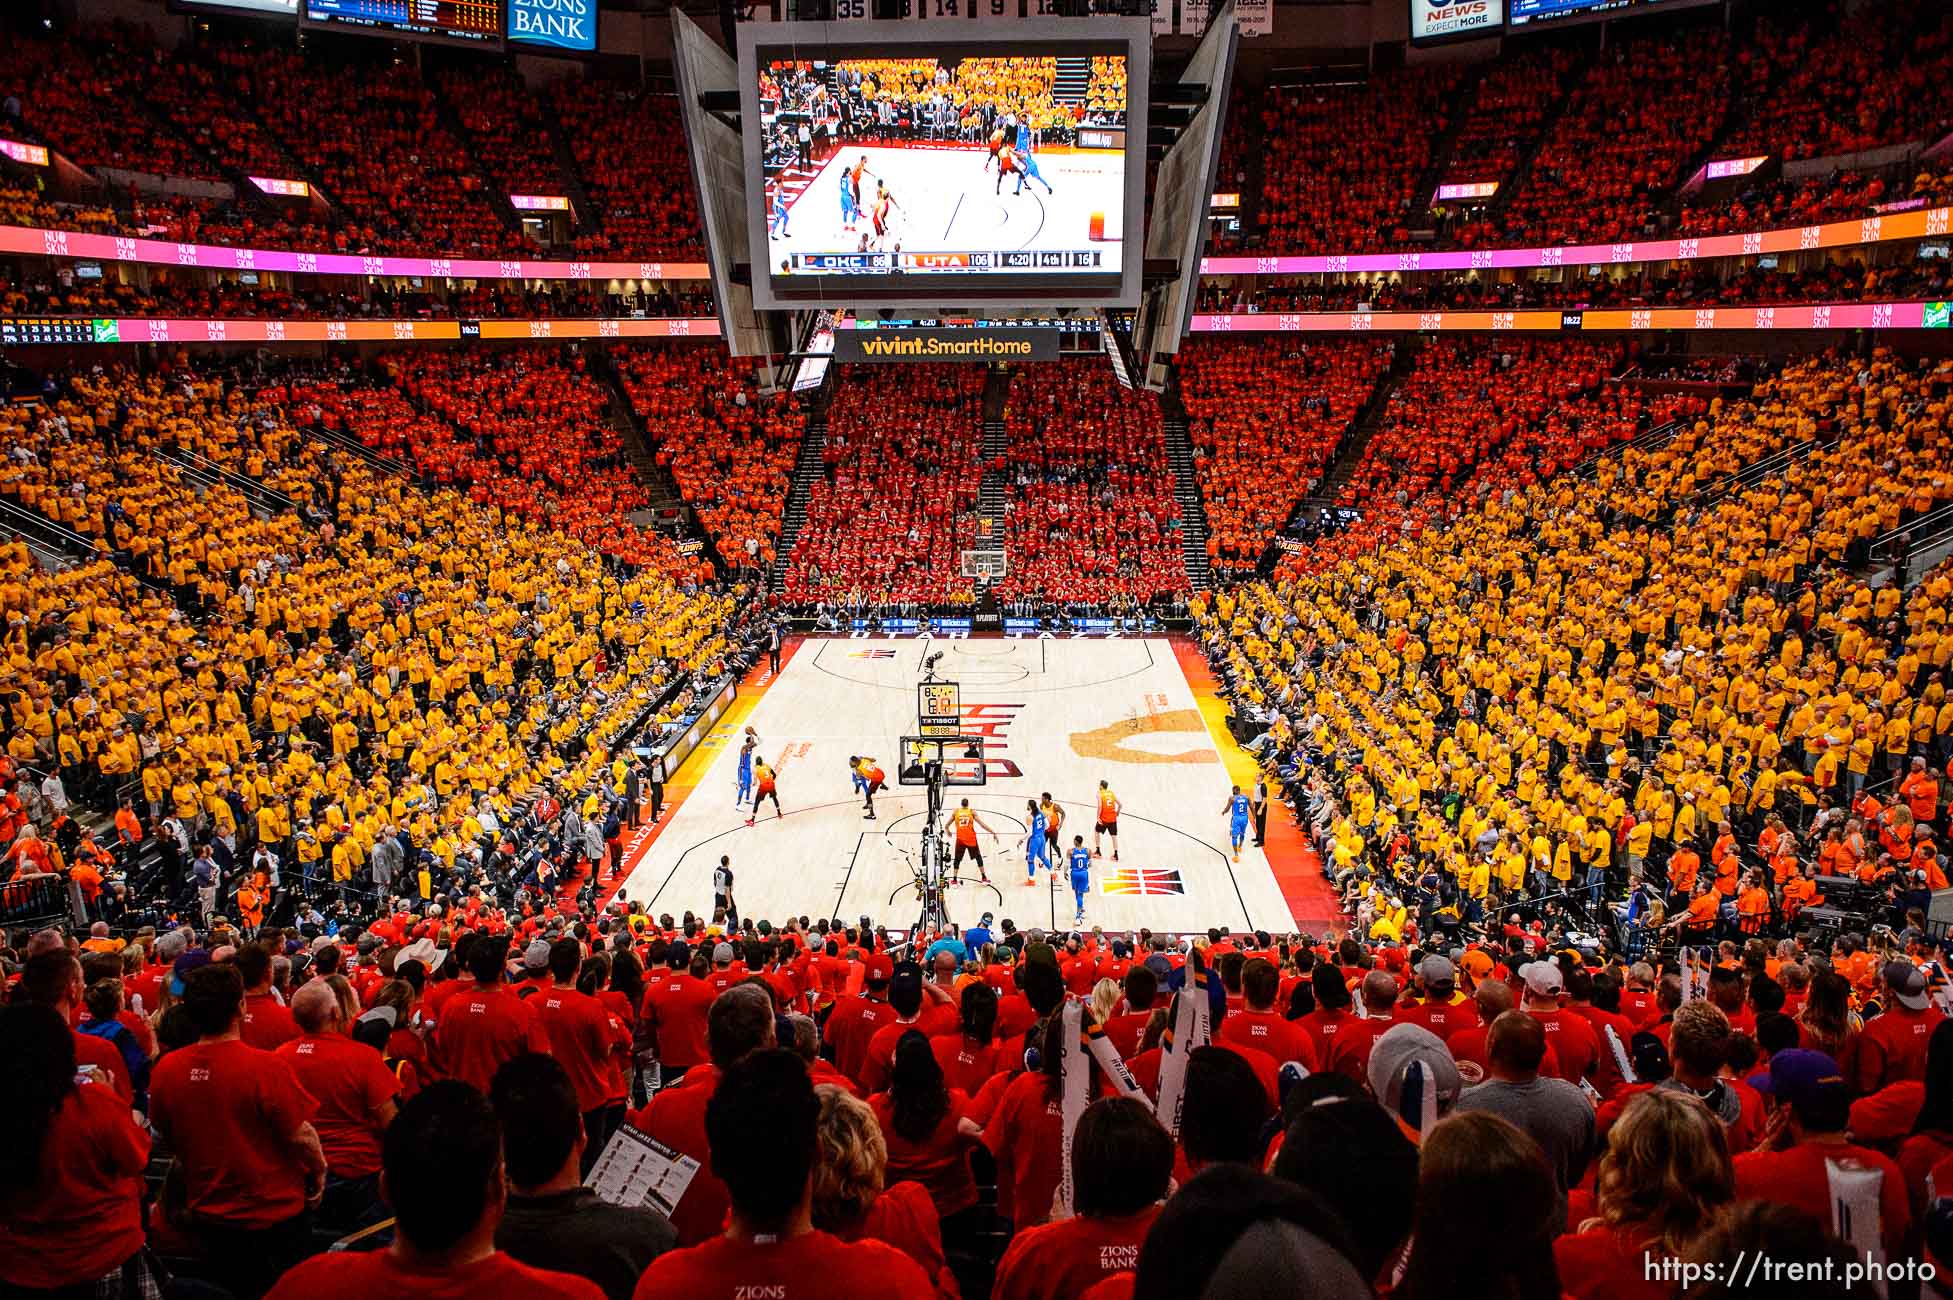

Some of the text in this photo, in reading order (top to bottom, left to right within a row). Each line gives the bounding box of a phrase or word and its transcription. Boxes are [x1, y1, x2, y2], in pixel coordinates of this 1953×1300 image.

[1427, 1, 1487, 22] NEWS
[514, 9, 585, 40] BANK
[1460, 14, 1488, 27] MORE
[824, 256, 885, 267] OKC 86
[924, 254, 988, 267] UTA 106
[1008, 254, 1029, 266] 4:20
[1043, 254, 1060, 266] 4th
[1078, 254, 1090, 265] 16
[1280, 543, 1303, 552] PLAYOFF
[1239, 803, 1245, 813] 2
[1078, 858, 1084, 868] 0
[1099, 1244, 1138, 1258] ZIONS
[1100, 1256, 1137, 1269] BANK
[735, 1285, 785, 1300] ZIONS
